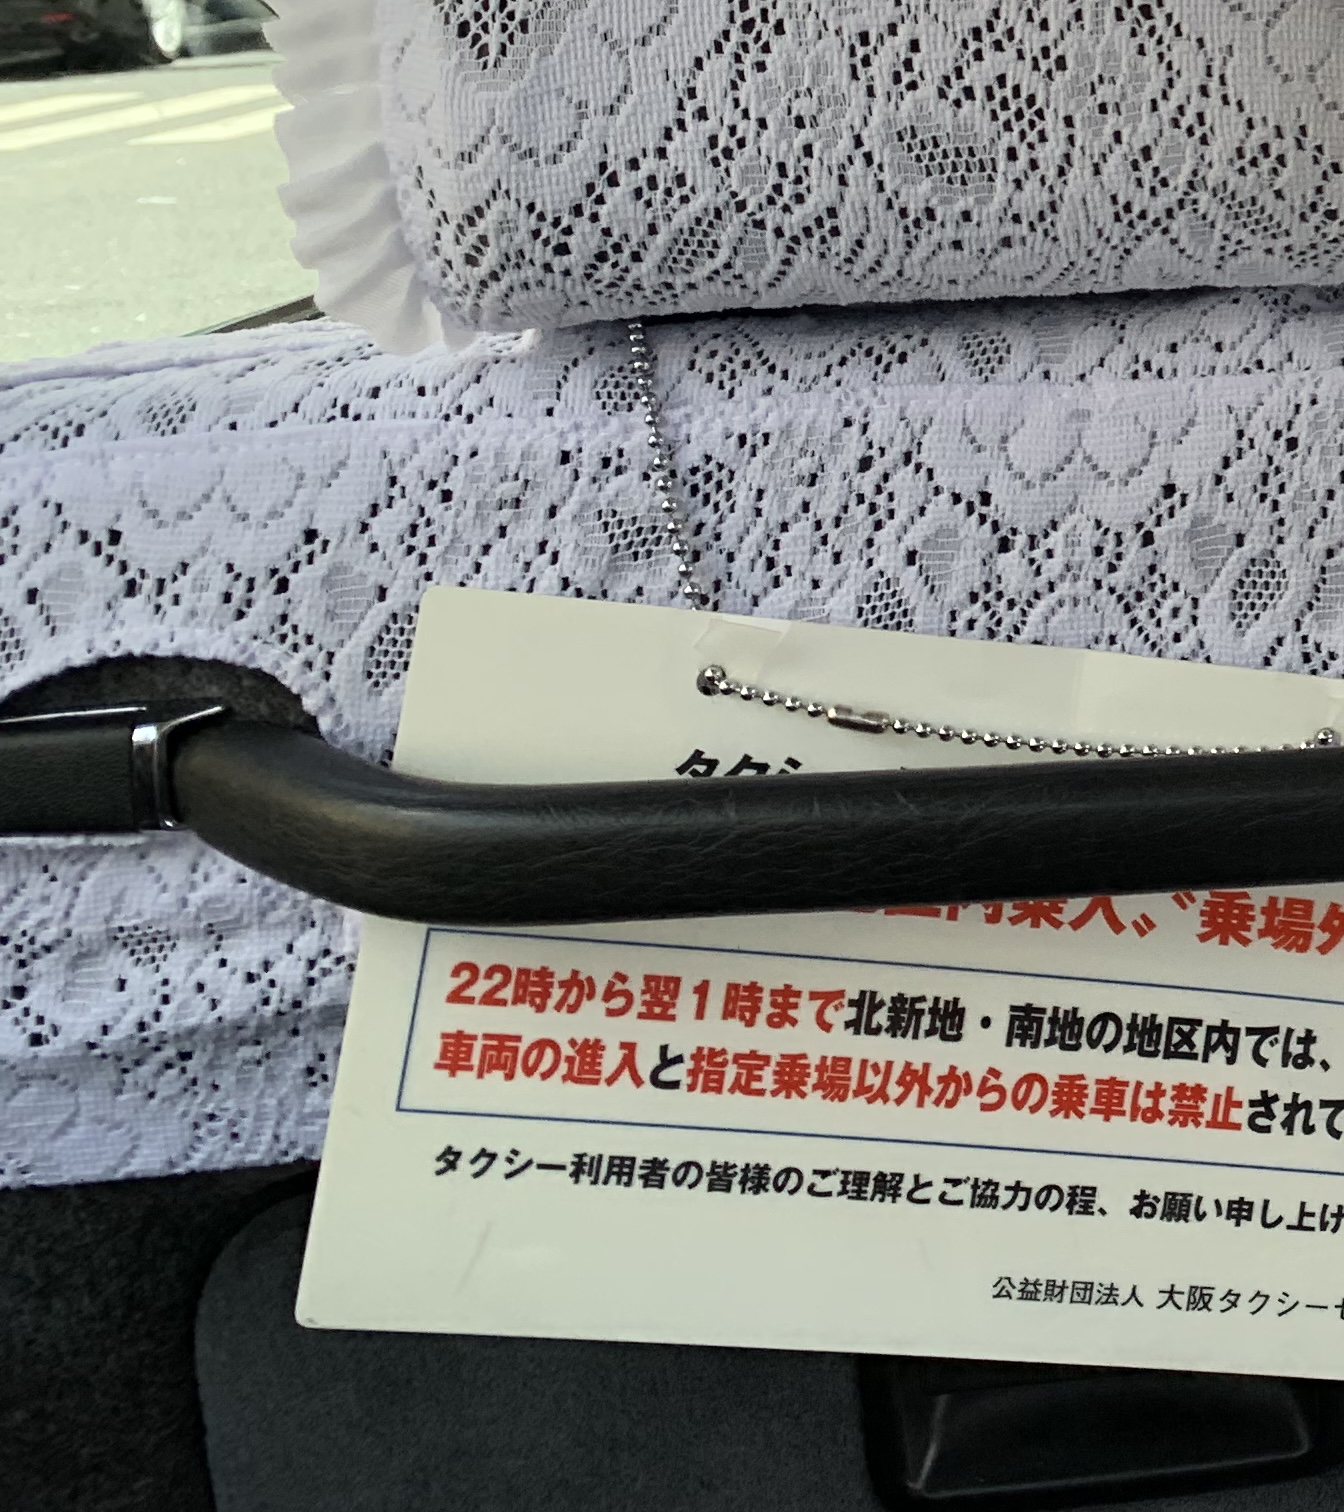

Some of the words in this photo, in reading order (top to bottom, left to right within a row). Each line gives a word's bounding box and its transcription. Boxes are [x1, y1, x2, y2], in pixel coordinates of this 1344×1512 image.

[991, 1276, 1144, 1308] 公益財団法人
